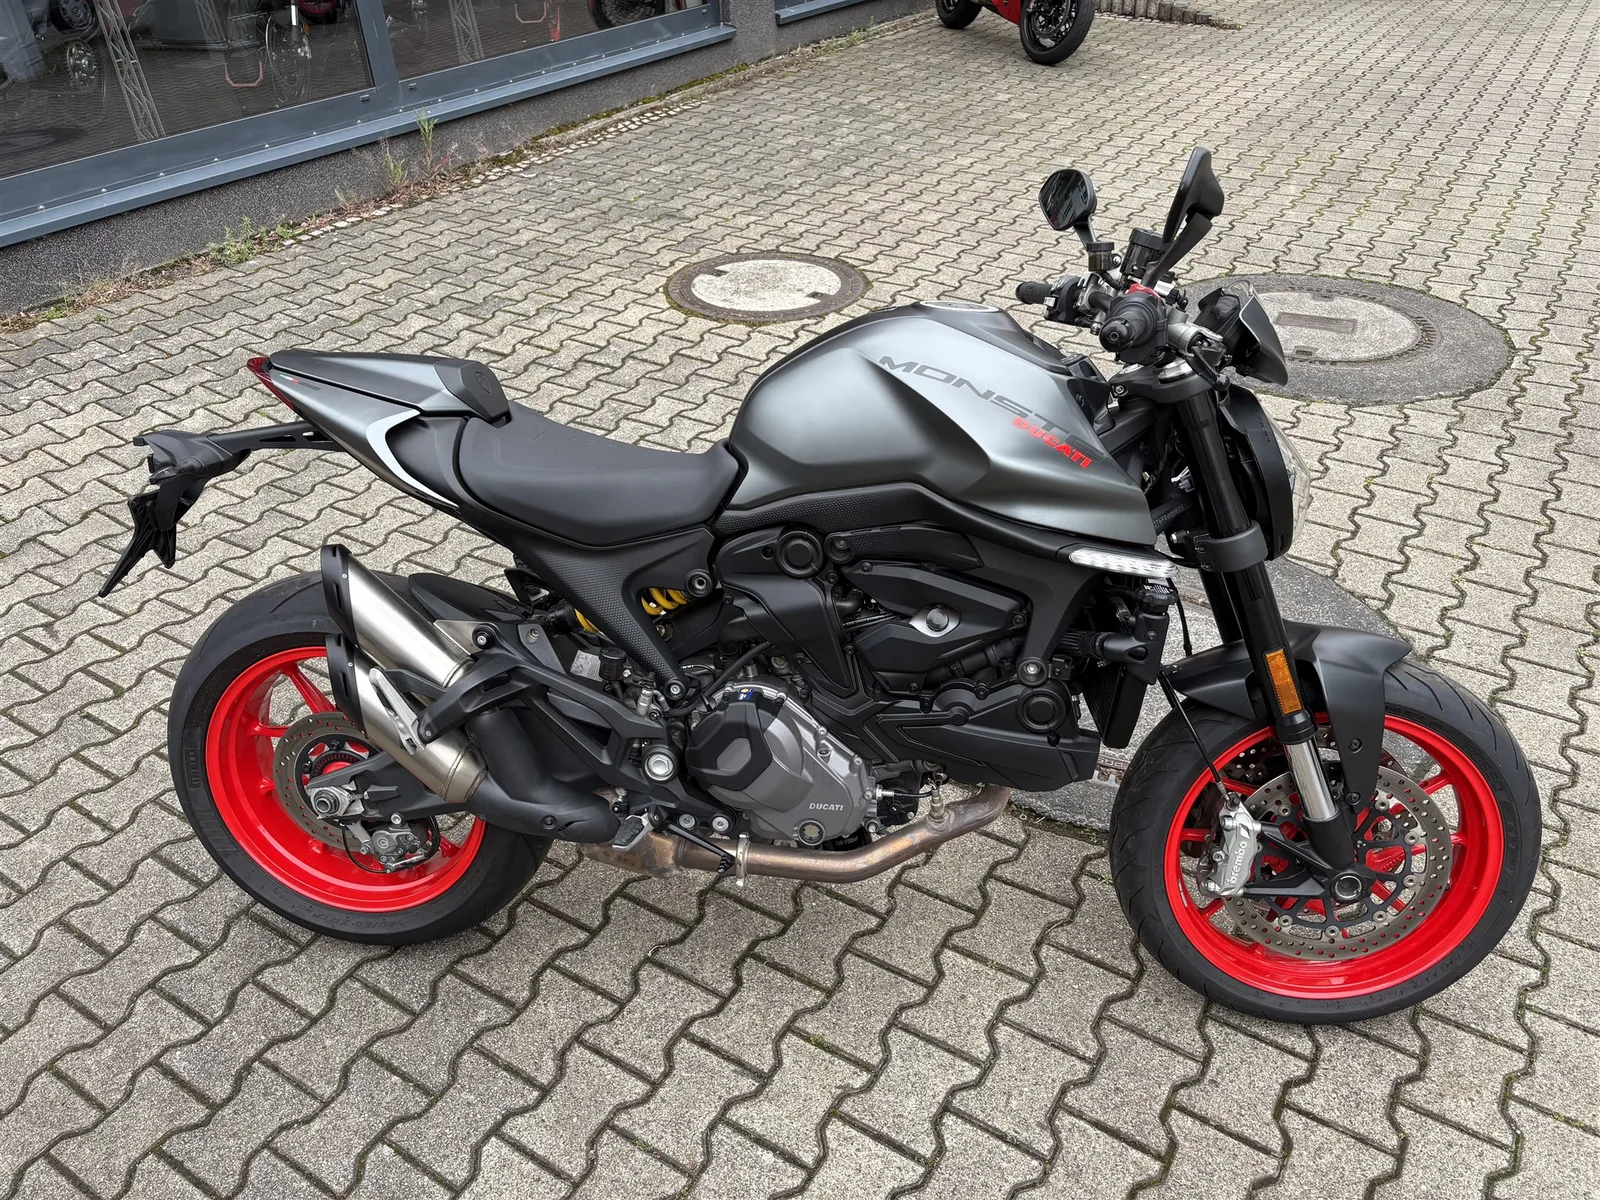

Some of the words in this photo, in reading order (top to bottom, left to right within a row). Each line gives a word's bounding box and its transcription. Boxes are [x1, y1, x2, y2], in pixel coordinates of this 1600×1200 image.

[1012, 416, 1093, 469] DUCATI
[809, 802, 844, 812] DUCATI
[1226, 841, 1248, 884] brembo
